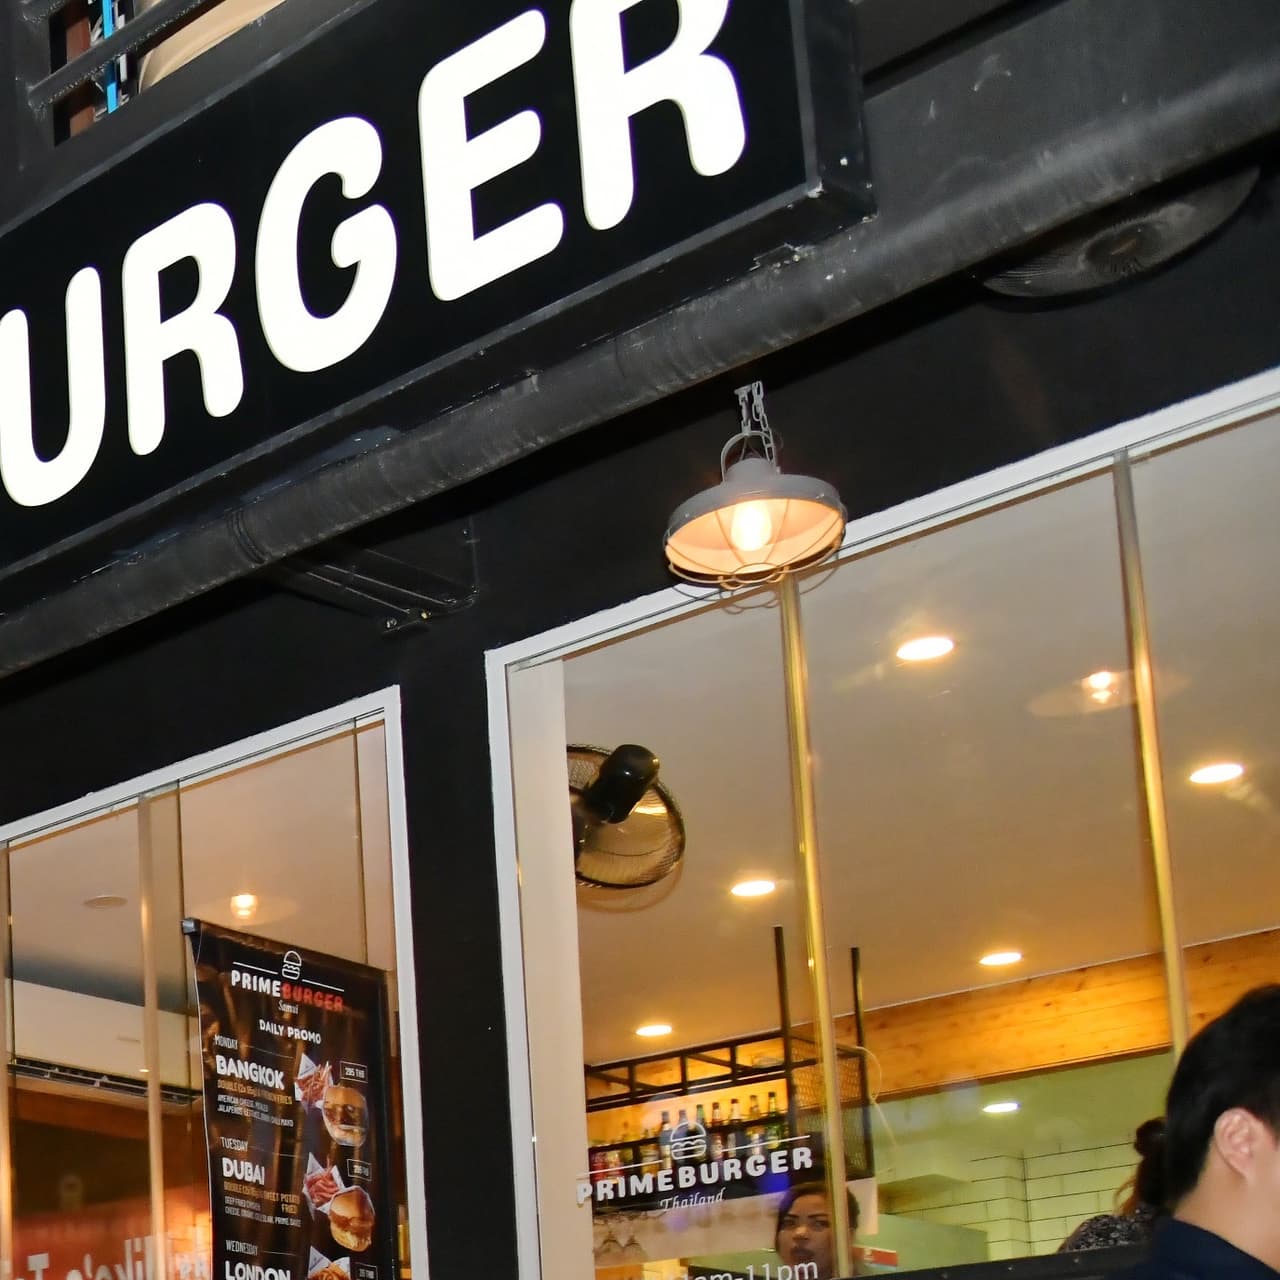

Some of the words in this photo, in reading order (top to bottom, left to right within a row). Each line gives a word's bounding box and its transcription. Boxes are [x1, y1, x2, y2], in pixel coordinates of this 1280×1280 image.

[231, 970, 343, 1012] PRIMEBURGER
[214, 1034, 239, 1049] MONDAY
[259, 1019, 284, 1037] DAILY
[287, 1026, 321, 1045] PROMO
[216, 1054, 285, 1090] BANGKOK
[220, 1137, 248, 1152] TUESDAY
[222, 1157, 265, 1185] DUBAI
[576, 1146, 813, 1206] PRIMEBURGER
[659, 1187, 726, 1212] Thailand
[225, 1240, 258, 1256] WEDNESDAY
